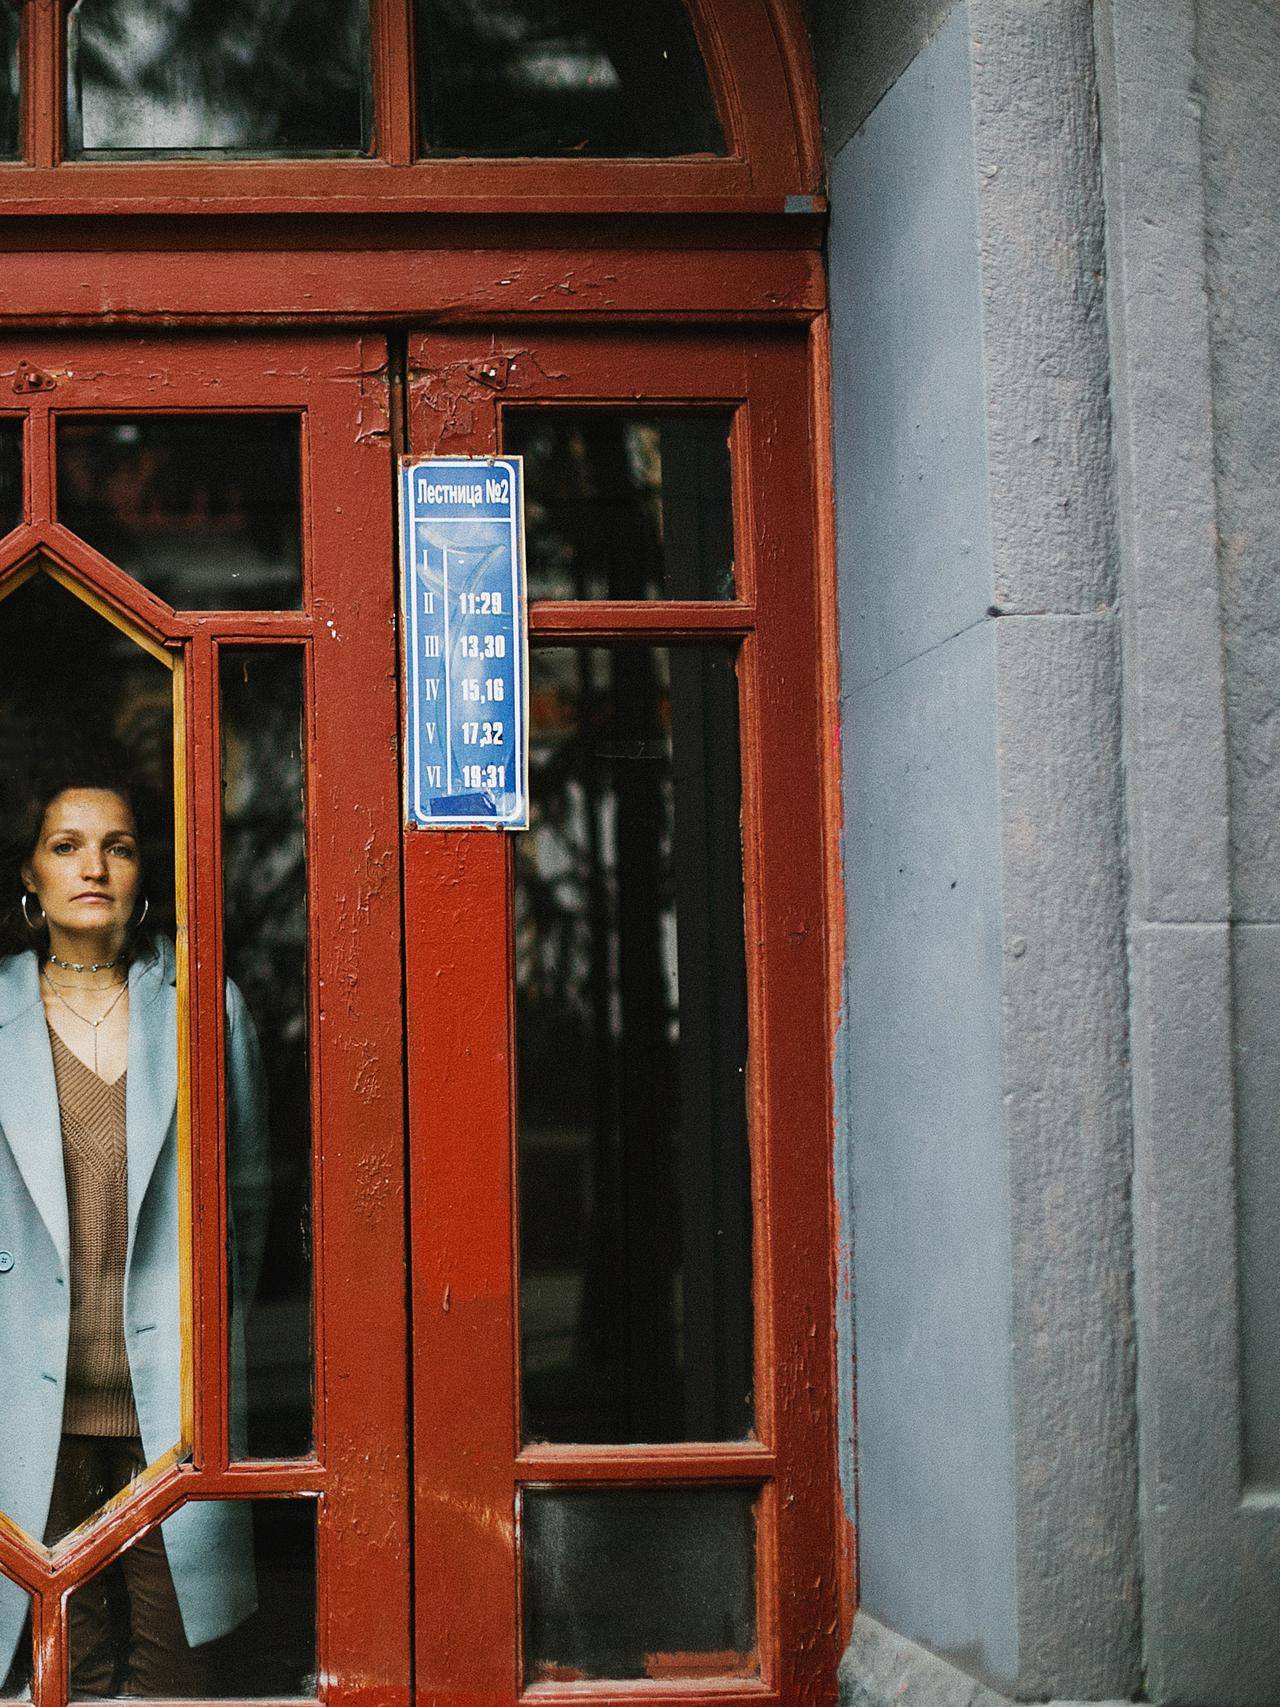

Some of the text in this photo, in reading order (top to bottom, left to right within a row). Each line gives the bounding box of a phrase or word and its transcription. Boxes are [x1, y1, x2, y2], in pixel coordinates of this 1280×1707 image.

[417, 478, 509, 508] Лестница №2
[423, 592, 434, 614] II
[424, 635, 440, 658] III
[425, 678, 440, 701] IV
[425, 722, 436, 744] V
[426, 765, 442, 788] VI
